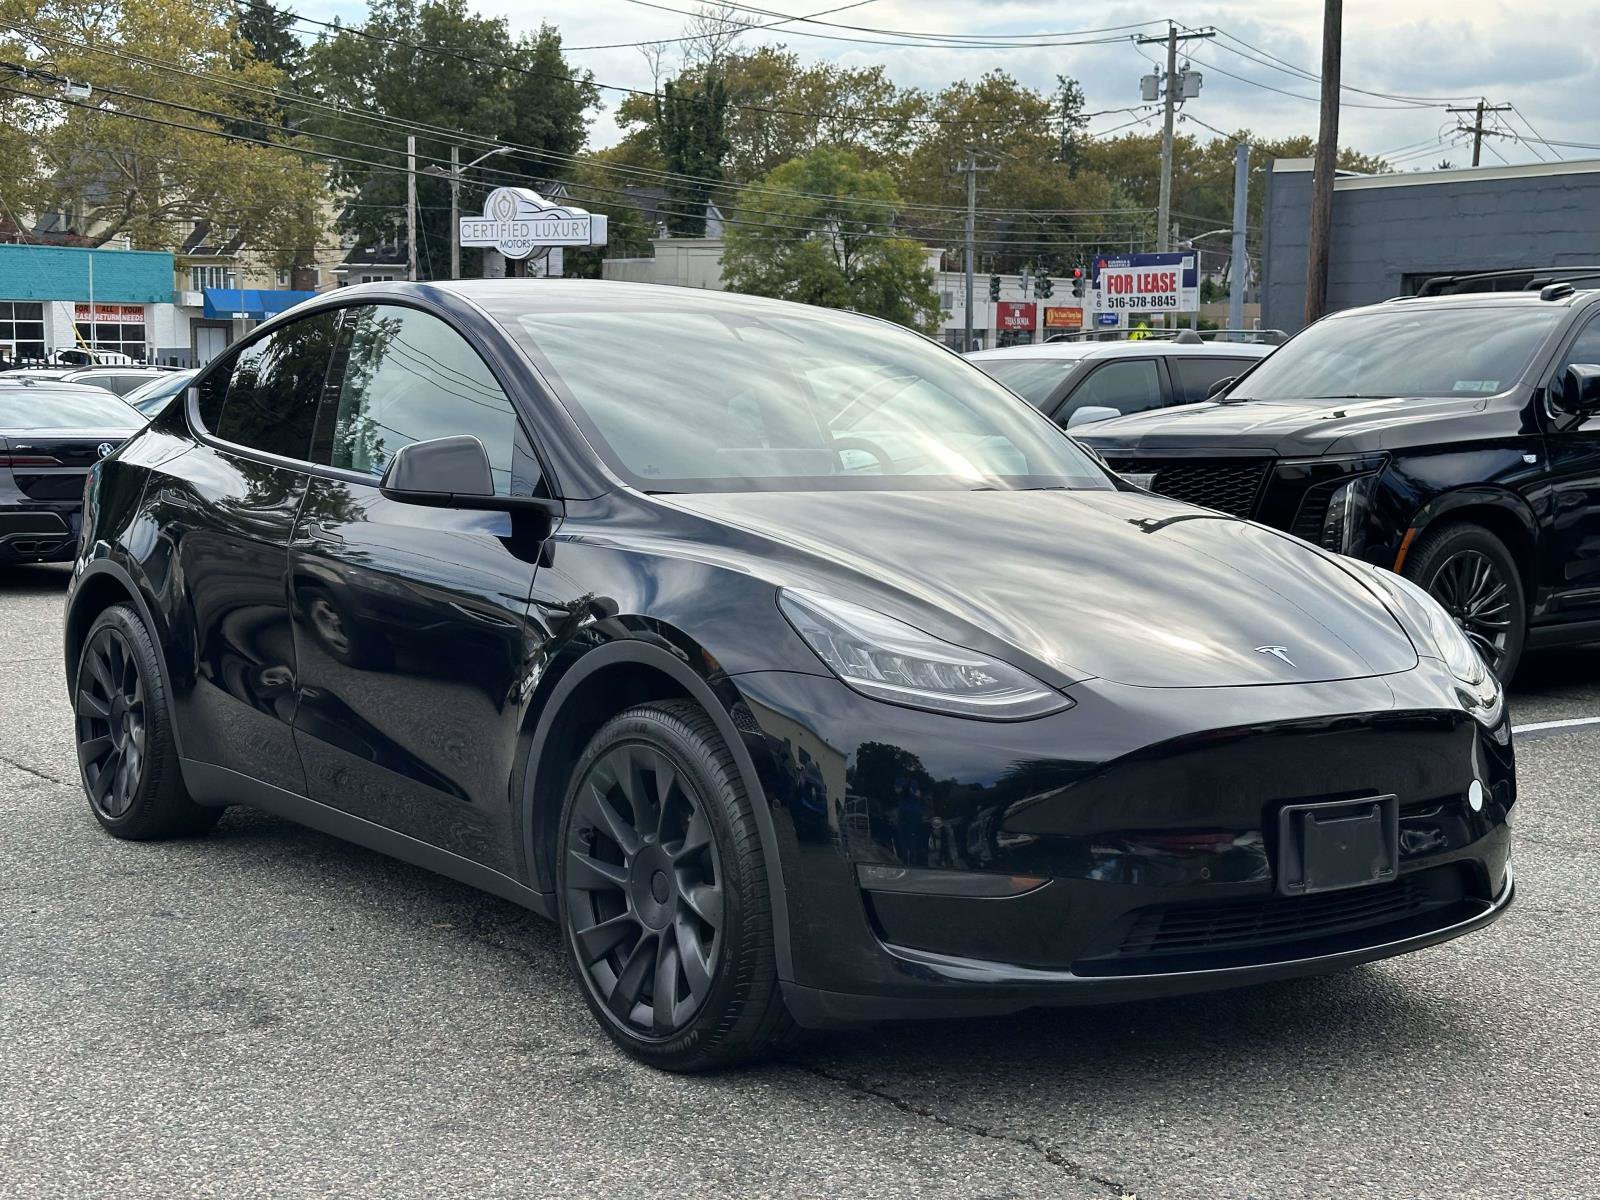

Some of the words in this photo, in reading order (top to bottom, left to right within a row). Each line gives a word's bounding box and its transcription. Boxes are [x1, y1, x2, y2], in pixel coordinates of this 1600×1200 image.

[461, 223, 530, 239] CERTIFIED
[535, 222, 589, 237] LUXURY
[500, 239, 531, 249] MOTORS
[1107, 274, 1134, 295] FOR
[1137, 272, 1177, 293] LEASE
[1108, 295, 1177, 308] 516-578-8845
[75, 304, 89, 312] FOR
[101, 305, 114, 313] ALL
[123, 306, 143, 314] YOUR
[95, 313, 121, 321] RETURN
[122, 314, 144, 322] NEEDS
